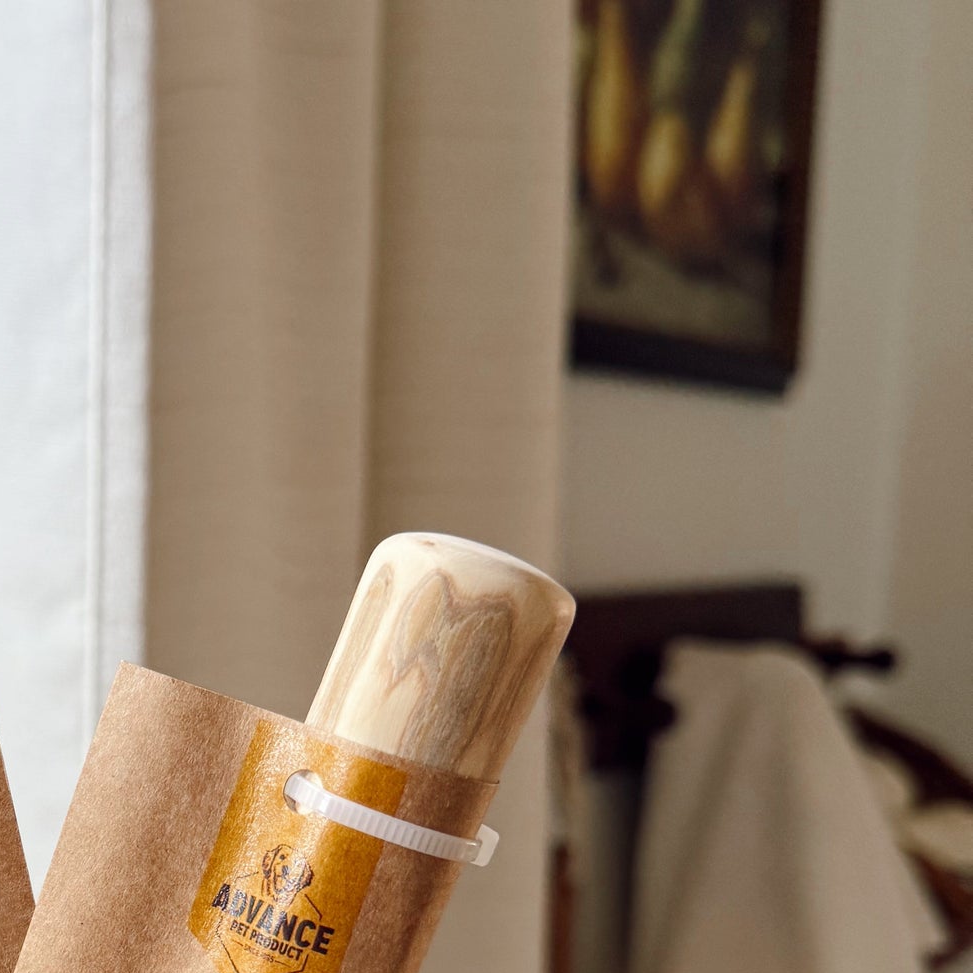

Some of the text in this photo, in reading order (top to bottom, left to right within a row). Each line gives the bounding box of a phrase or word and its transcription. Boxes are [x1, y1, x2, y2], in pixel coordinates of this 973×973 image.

[212, 883, 335, 955] ADVANCE
[230, 919, 249, 937] PET
[249, 929, 303, 961] PRODUCT
